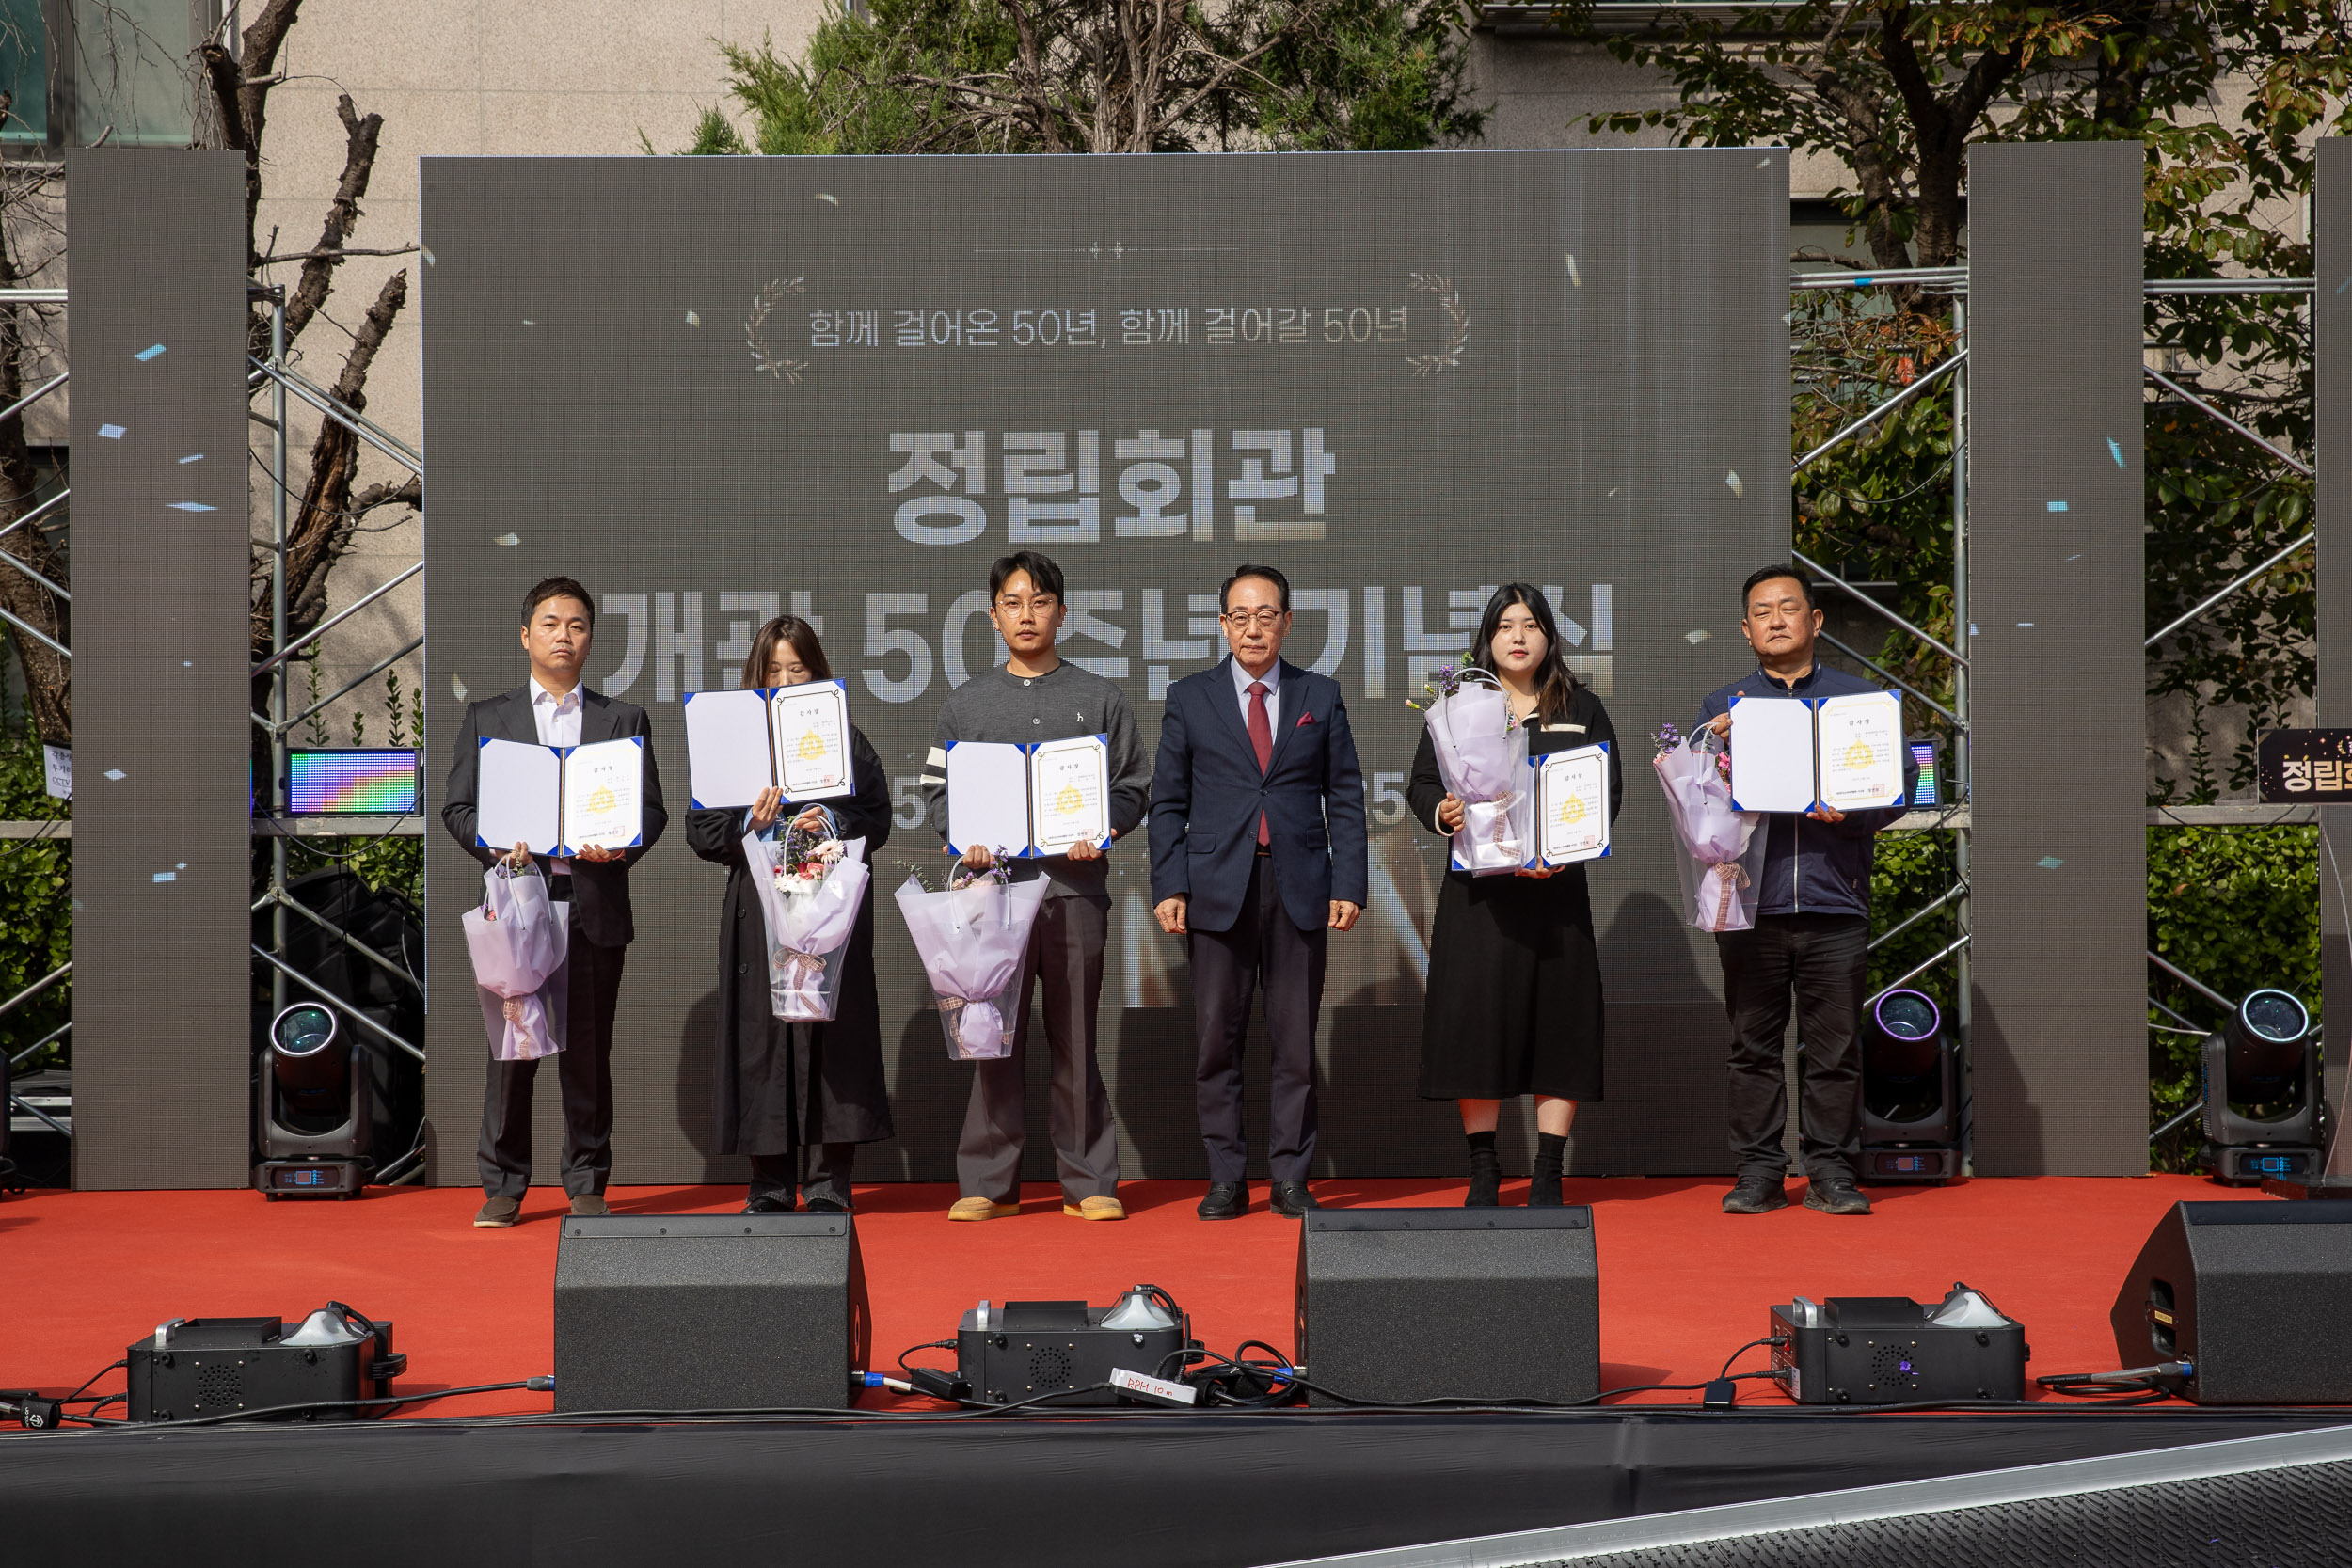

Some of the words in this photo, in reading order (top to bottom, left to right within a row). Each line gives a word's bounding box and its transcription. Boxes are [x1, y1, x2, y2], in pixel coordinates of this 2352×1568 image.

[810, 309, 879, 348] 함께
[893, 308, 1000, 347] 걸어온
[1012, 308, 1107, 349] 50년,
[1120, 307, 1189, 345] 함께
[1205, 306, 1311, 345] 걸어갈
[1324, 305, 1407, 344] 50년
[888, 427, 1336, 546] 정립회관
[52, 776, 71, 786] CCTV
[2282, 760, 2352, 792] 정립
[1127, 1377, 1150, 1392] RPM
[1154, 1386, 1164, 1395] 10
